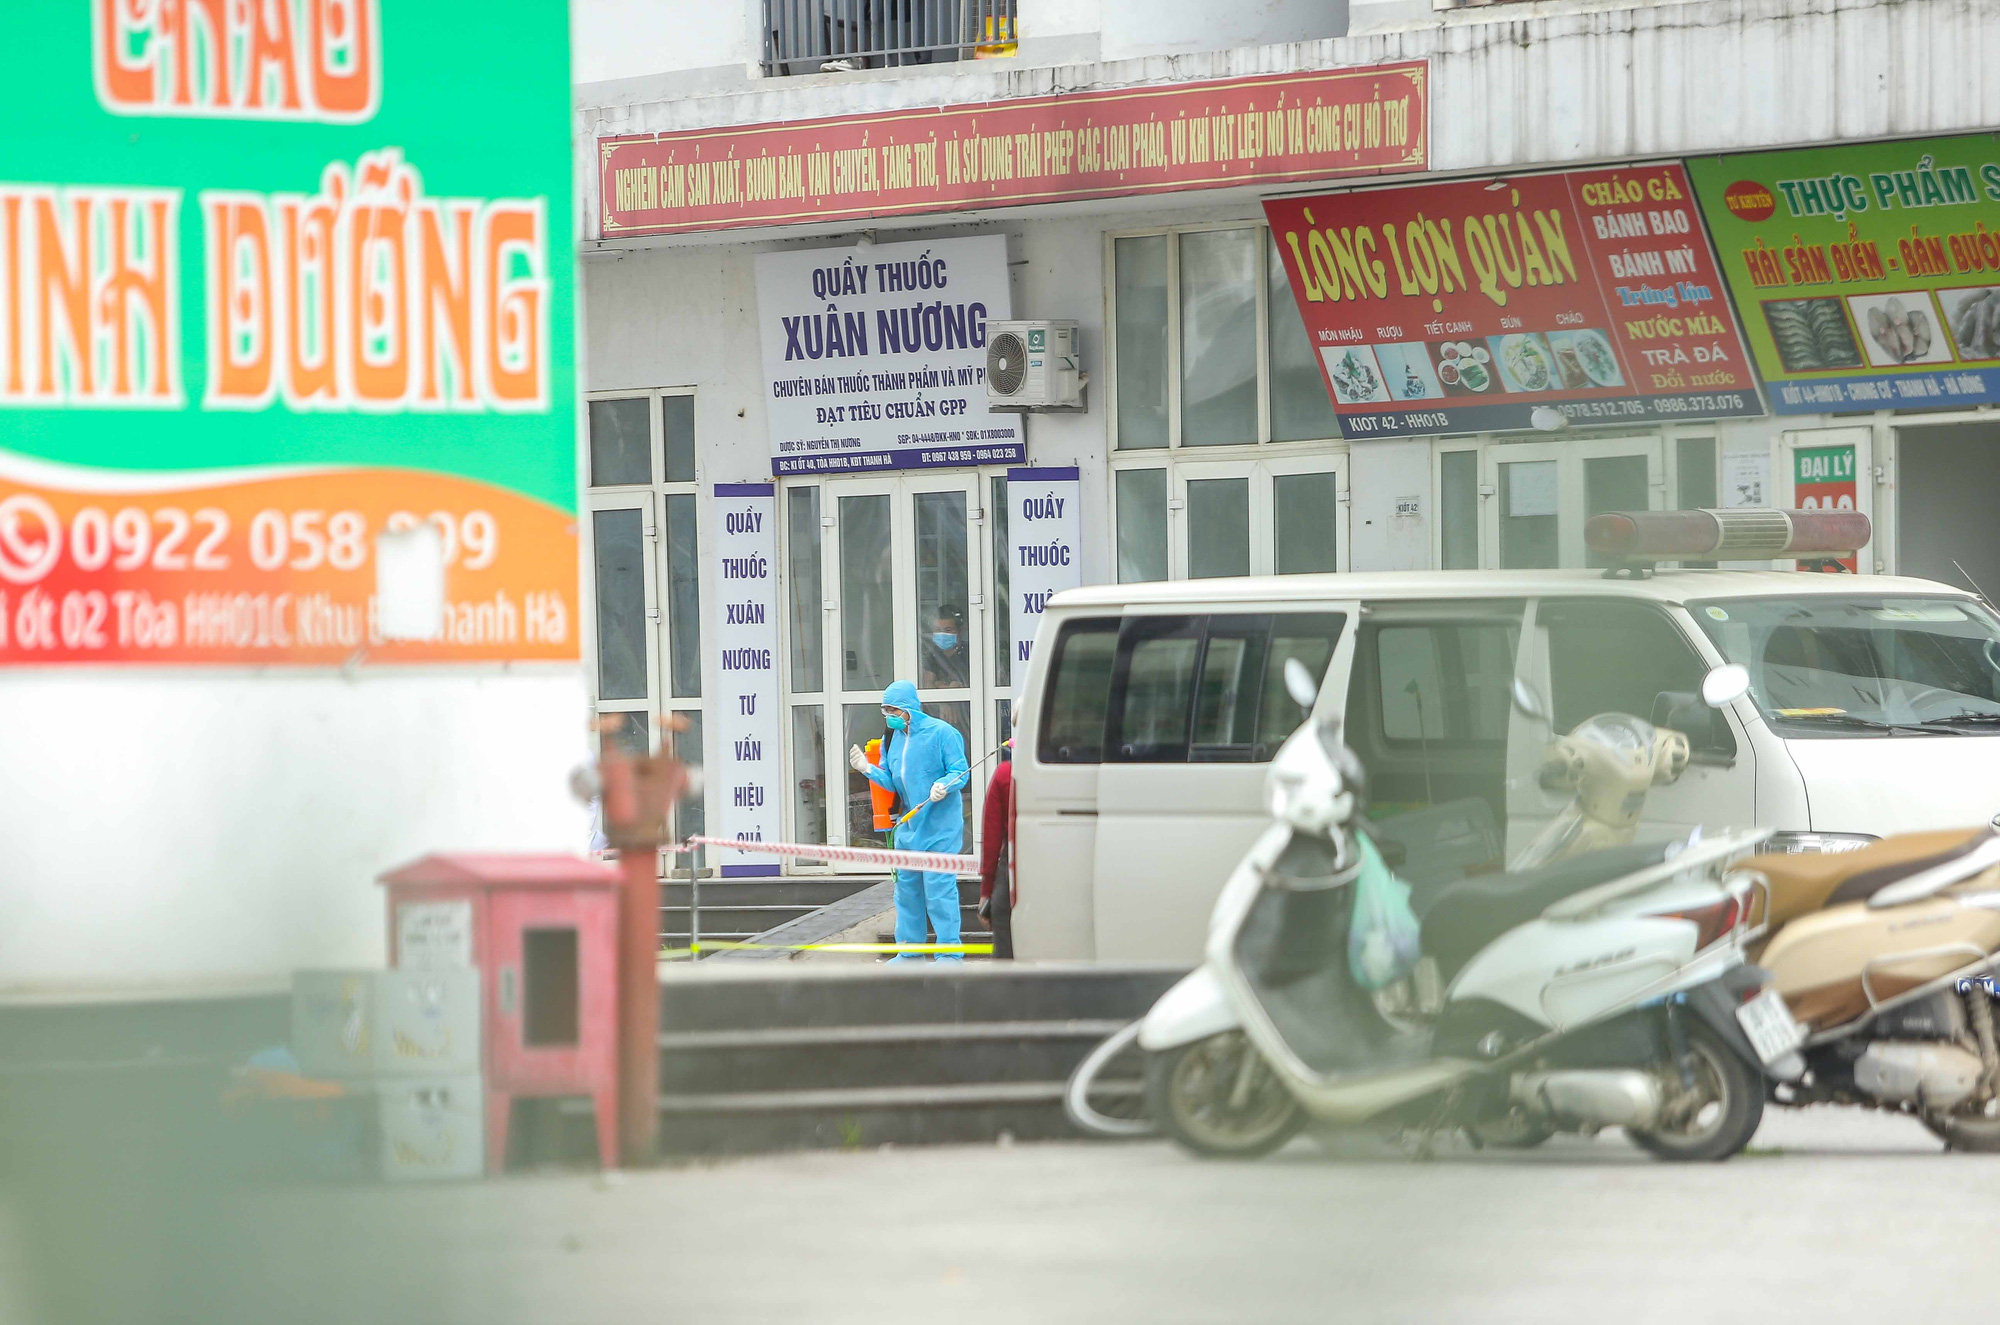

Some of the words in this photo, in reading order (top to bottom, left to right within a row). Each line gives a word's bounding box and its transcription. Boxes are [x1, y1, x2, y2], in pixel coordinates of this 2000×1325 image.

[615, 158, 658, 212] NGHIÊM
[660, 149, 685, 209] CẤM
[687, 144, 710, 207] SẢN
[712, 144, 744, 208] XUẤT,
[746, 147, 776, 202] BUÔN
[778, 145, 805, 203] BÁN,
[807, 143, 830, 206] VẬN
[832, 129, 880, 197] CHUYỂN,
[882, 136, 912, 190] TÀNG
[914, 130, 939, 191] TRỮ,
[945, 130, 960, 185] VÀ
[962, 118, 980, 184] SỬ
[981, 134, 1013, 191] DỤNG
[1015, 123, 1041, 179] TRÁI
[1044, 120, 1074, 176] PHÉP
[1077, 118, 1100, 174] CÁC
[1103, 124, 1130, 180] LOẠI
[1132, 112, 1168, 172] PHÁO,
[1170, 110, 1186, 165] VŨ
[1189, 106, 1209, 164] KHÍ
[1212, 105, 1235, 172] VẬT
[1237, 102, 1264, 169] LIỆU
[1266, 90, 1285, 157] NỔ
[1287, 98, 1303, 155] VÀ
[1306, 96, 1340, 154] CÔNG
[1343, 102, 1361, 161] CỤ
[1363, 82, 1381, 149] HỖ
[1384, 94, 1409, 157] TRỢ
[1581, 174, 1643, 206] CHÁO
[1646, 170, 1683, 201] GÀ
[1777, 172, 1867, 221] THỰC
[1869, 154, 1979, 210] PHẨM
[1592, 209, 1649, 240] BÁNH
[1647, 208, 1690, 235] BAO
[1285, 206, 1387, 303] LÒNG
[1382, 211, 1467, 314] LỢN
[1464, 188, 1577, 307] QUÁN
[1608, 248, 1665, 278] BÁNH
[1664, 243, 1697, 274] MỲ
[1741, 236, 1788, 287] HẢI
[1782, 234, 1833, 286] SẢN
[1829, 221, 1886, 284] BIỂN
[1897, 224, 1951, 277] BÁN
[199, 147, 550, 413] DƯỠNG
[812, 255, 868, 300] QUẦY
[875, 249, 947, 294] THUỐC
[1615, 283, 1678, 308] Trứng
[1676, 281, 1713, 306] lộn
[781, 303, 868, 362] XUÂN
[876, 300, 987, 355] NƯƠNG
[1376, 325, 1403, 339] RƯỢU
[1424, 318, 1444, 335] TIẾT
[1445, 321, 1473, 334] CANH
[1500, 316, 1522, 329] BÚN
[1555, 311, 1584, 325] CHÁO
[1624, 313, 1684, 340] NƯỚC
[1684, 310, 1726, 336] MÍA
[1318, 329, 1338, 342] MÓN
[1339, 326, 1363, 342] NHẬU
[1641, 342, 1691, 366] TRÀ
[1692, 341, 1728, 363] ĐÁ
[773, 375, 813, 398] CHUYÊN
[814, 374, 835, 395] BÁN
[837, 369, 870, 394] THUỐC
[872, 370, 906, 392] THÀNH
[909, 363, 939, 389] PHẨM
[941, 366, 955, 387] VÀ
[957, 365, 974, 386] MỸ
[1651, 367, 1686, 388] Đổi
[1690, 369, 1736, 386] nước
[816, 406, 845, 427] ĐẠT
[849, 400, 880, 421] TIÊU
[885, 391, 935, 419] CHUẨN
[939, 398, 967, 416] GPP
[1655, 394, 1744, 413] 0986.373.076
[1349, 416, 1378, 432] KIOT
[1381, 415, 1399, 431] 42
[1404, 412, 1449, 430] HH01B
[862, 454, 883, 466] THANH
[883, 452, 892, 465] HÀ
[1800, 456, 1829, 482] ĐẠI
[1833, 450, 1853, 476] LÝ
[1022, 490, 1065, 522] QUẦY
[726, 510, 763, 536] QUẦY
[70, 506, 232, 571] 0922
[248, 507, 367, 571] 058
[1018, 537, 1070, 567] THUỐC
[722, 550, 767, 579] THUỐC
[60, 588, 109, 650] 02
[524, 589, 569, 645] Hà
[726, 599, 765, 625] XUÂN
[722, 647, 771, 670] NƯƠNG
[739, 693, 756, 716] TƯ
[734, 733, 762, 762] VẤN
[734, 781, 764, 812] HIỆU
